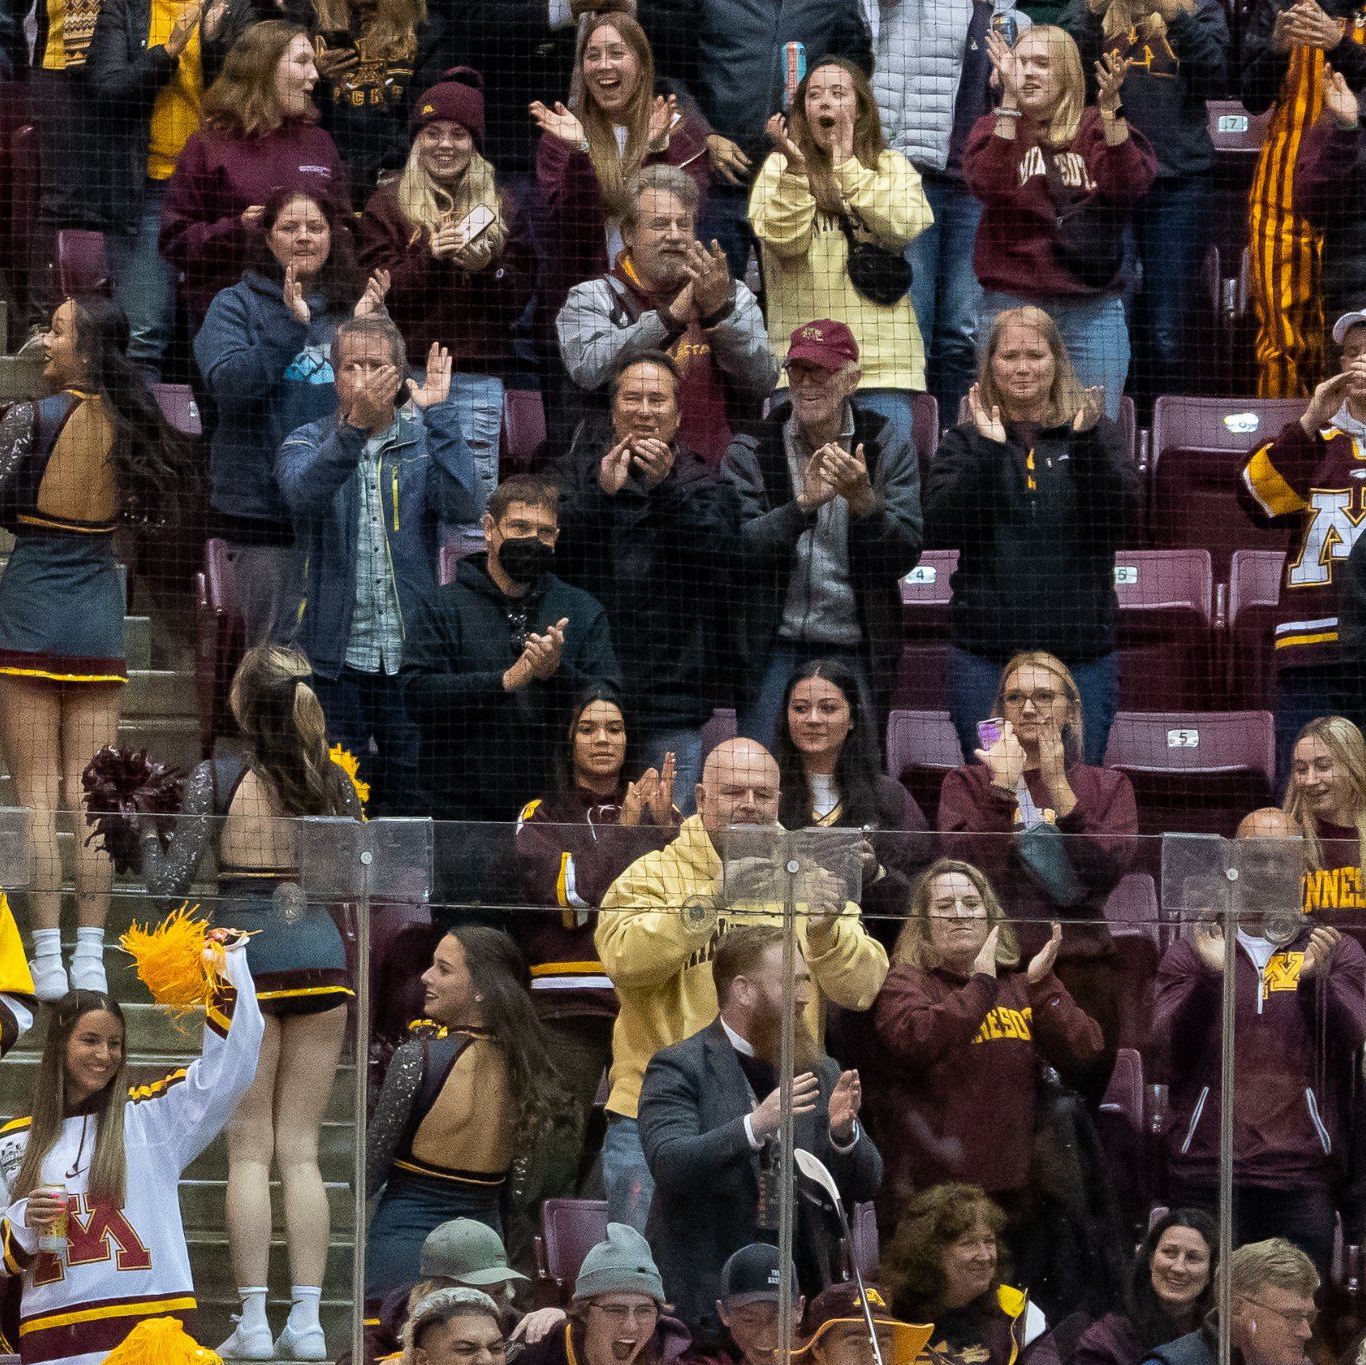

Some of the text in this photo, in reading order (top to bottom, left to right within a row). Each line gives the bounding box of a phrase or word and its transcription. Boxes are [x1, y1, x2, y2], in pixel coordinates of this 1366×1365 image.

[1229, 118, 1238, 129] 7
[915, 569, 923, 580] 4
[1116, 569, 1126, 581] 5
[1178, 732, 1187, 746] 5
